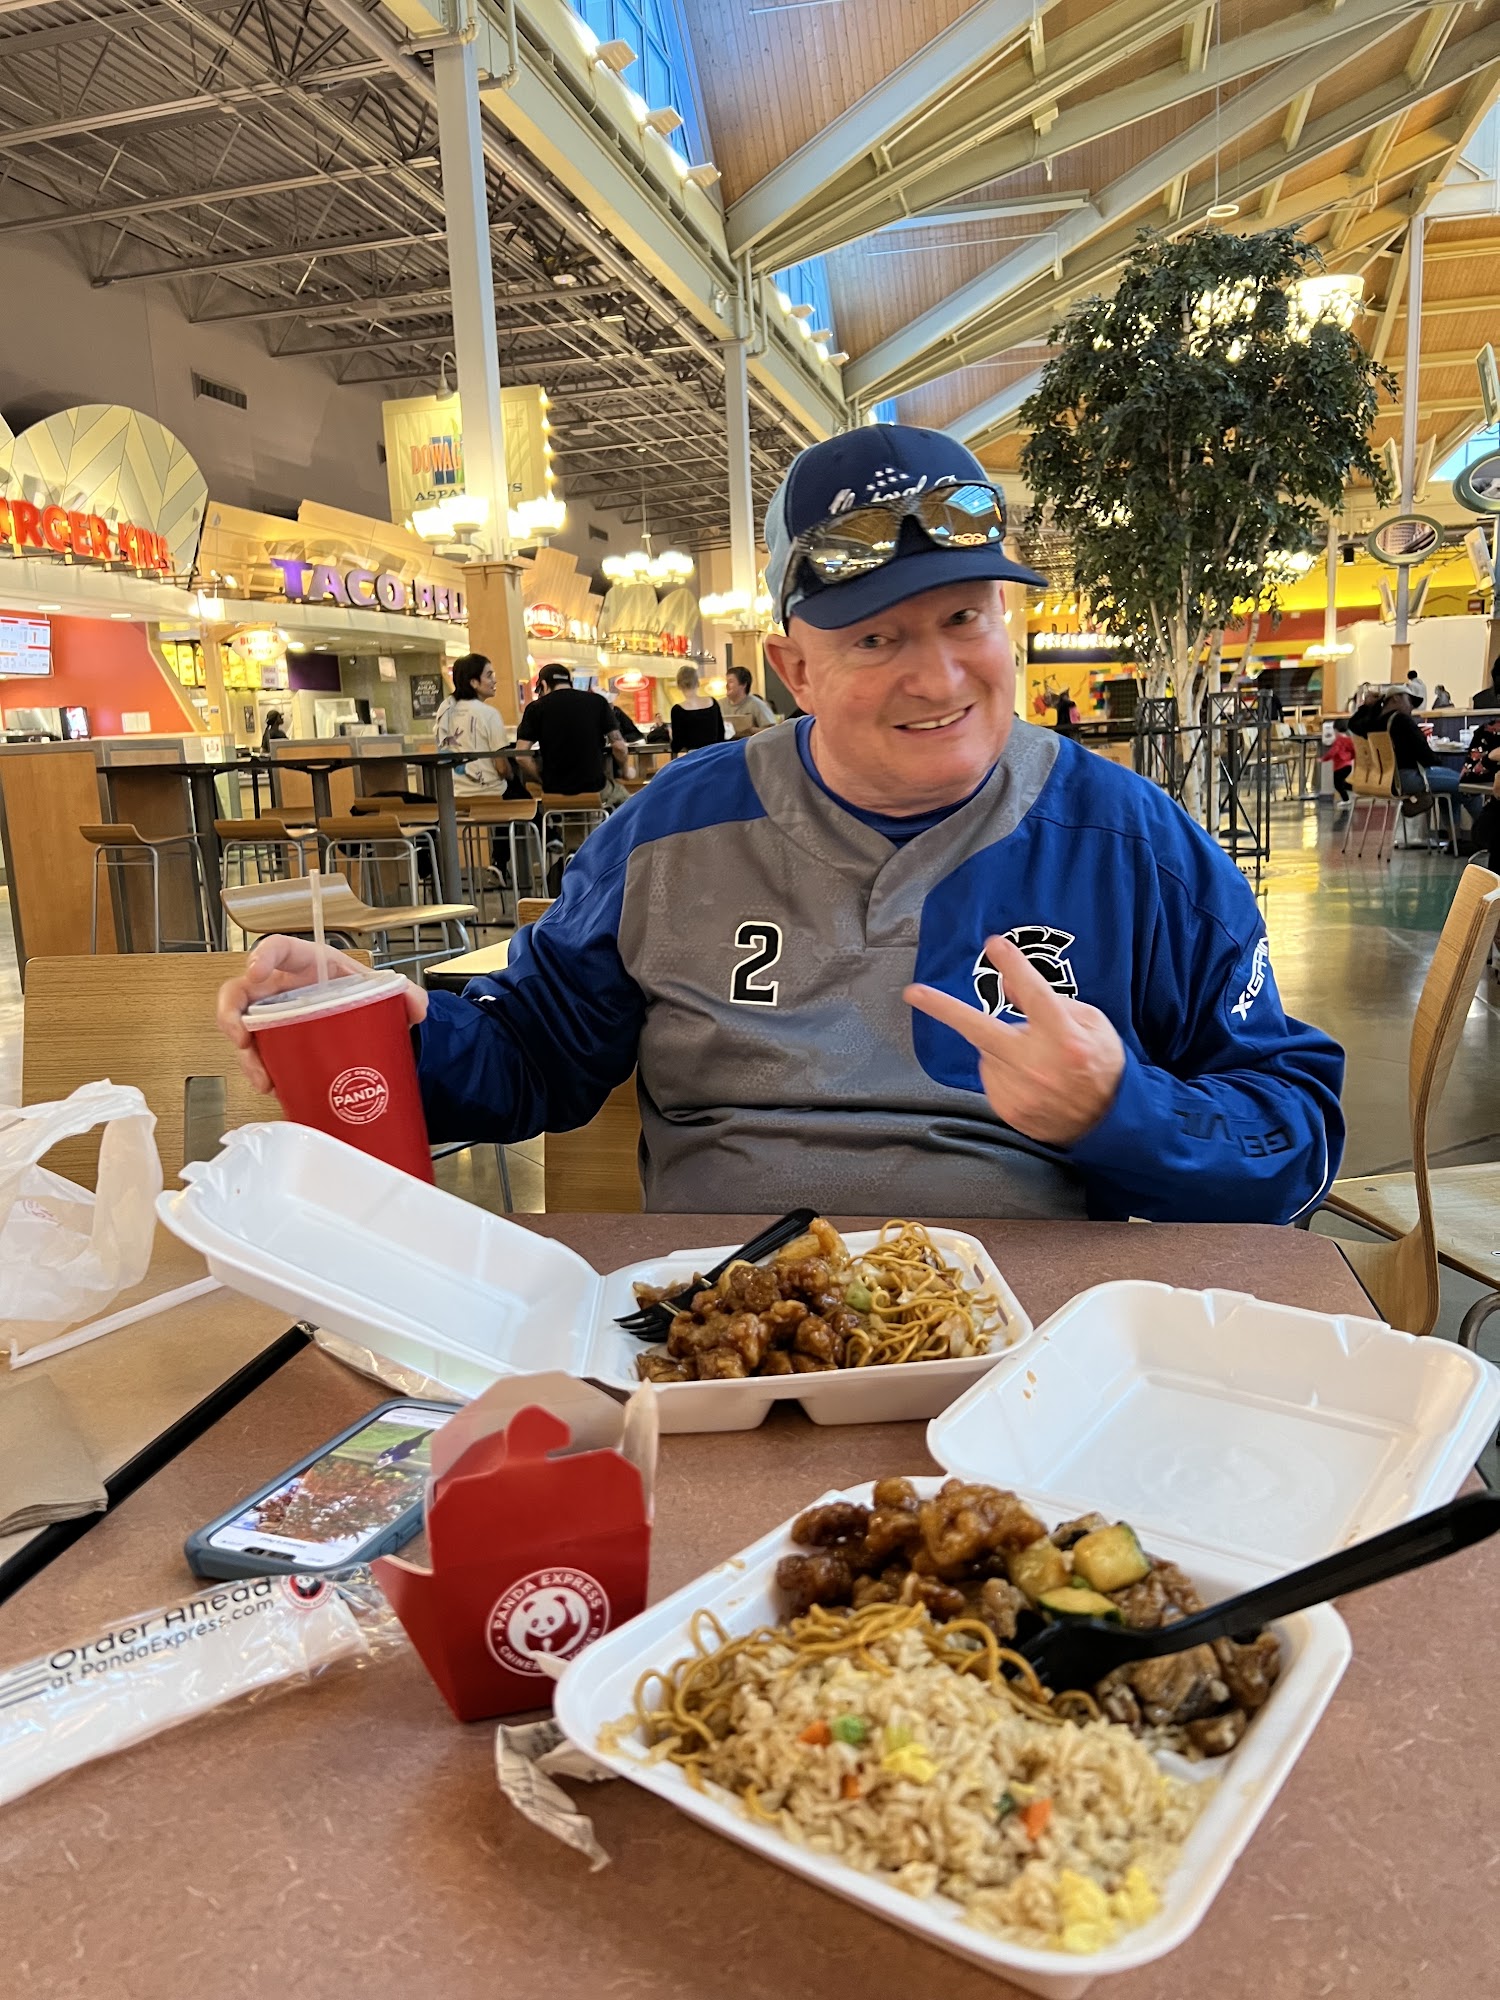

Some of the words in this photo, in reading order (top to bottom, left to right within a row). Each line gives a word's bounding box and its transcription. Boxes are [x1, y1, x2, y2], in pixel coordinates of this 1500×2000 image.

[410, 442, 462, 475] DOWAG
[270, 558, 407, 611] TACO
[729, 921, 783, 1006] 2
[333, 1083, 387, 1107] PANDA
[493, 1581, 538, 1629] PANDA
[540, 1573, 602, 1610] EXPRESS
[50, 1620, 151, 1670] Order
[51, 1671, 73, 1688] at
[81, 1597, 275, 1679] PandaExpress.com
